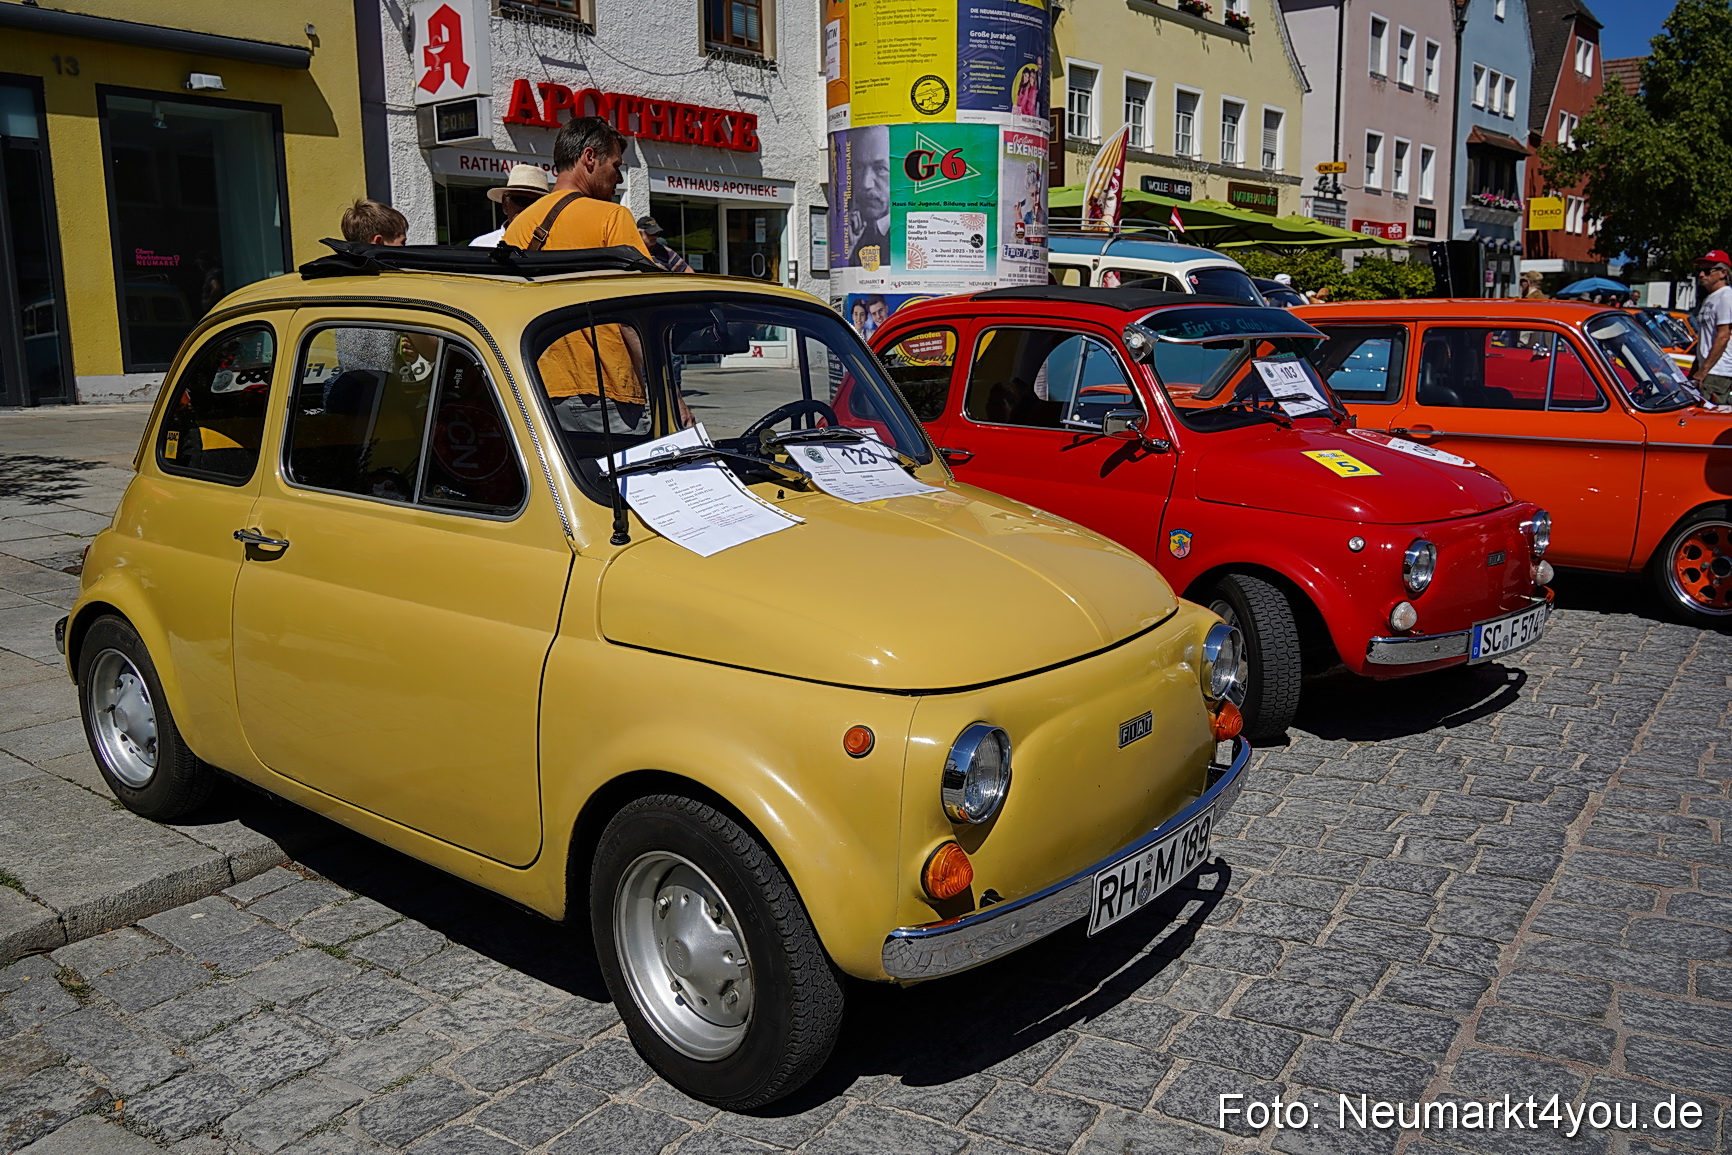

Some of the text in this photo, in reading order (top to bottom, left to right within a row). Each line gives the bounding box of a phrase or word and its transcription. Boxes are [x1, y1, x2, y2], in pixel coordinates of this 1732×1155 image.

[970, 30, 1016, 41] Große Jurahalle
[52, 55, 80, 76] 13
[502, 78, 760, 152] APOTHEKE
[904, 148, 966, 182] G6
[668, 176, 778, 198] RATHAUS APOTHEKE
[1147, 181, 1190, 196] WOLLE & MEHR
[1182, 321, 1214, 334] Fiat
[1280, 366, 1298, 379] 103
[841, 447, 878, 466] 123
[1337, 462, 1360, 472] 5
[1489, 553, 1505, 566] FIAT
[1482, 624, 1502, 655] SC
[1510, 618, 1519, 647] F
[1521, 610, 1540, 642] 574
[1121, 714, 1153, 746] FIAT
[1180, 816, 1211, 875] 189
